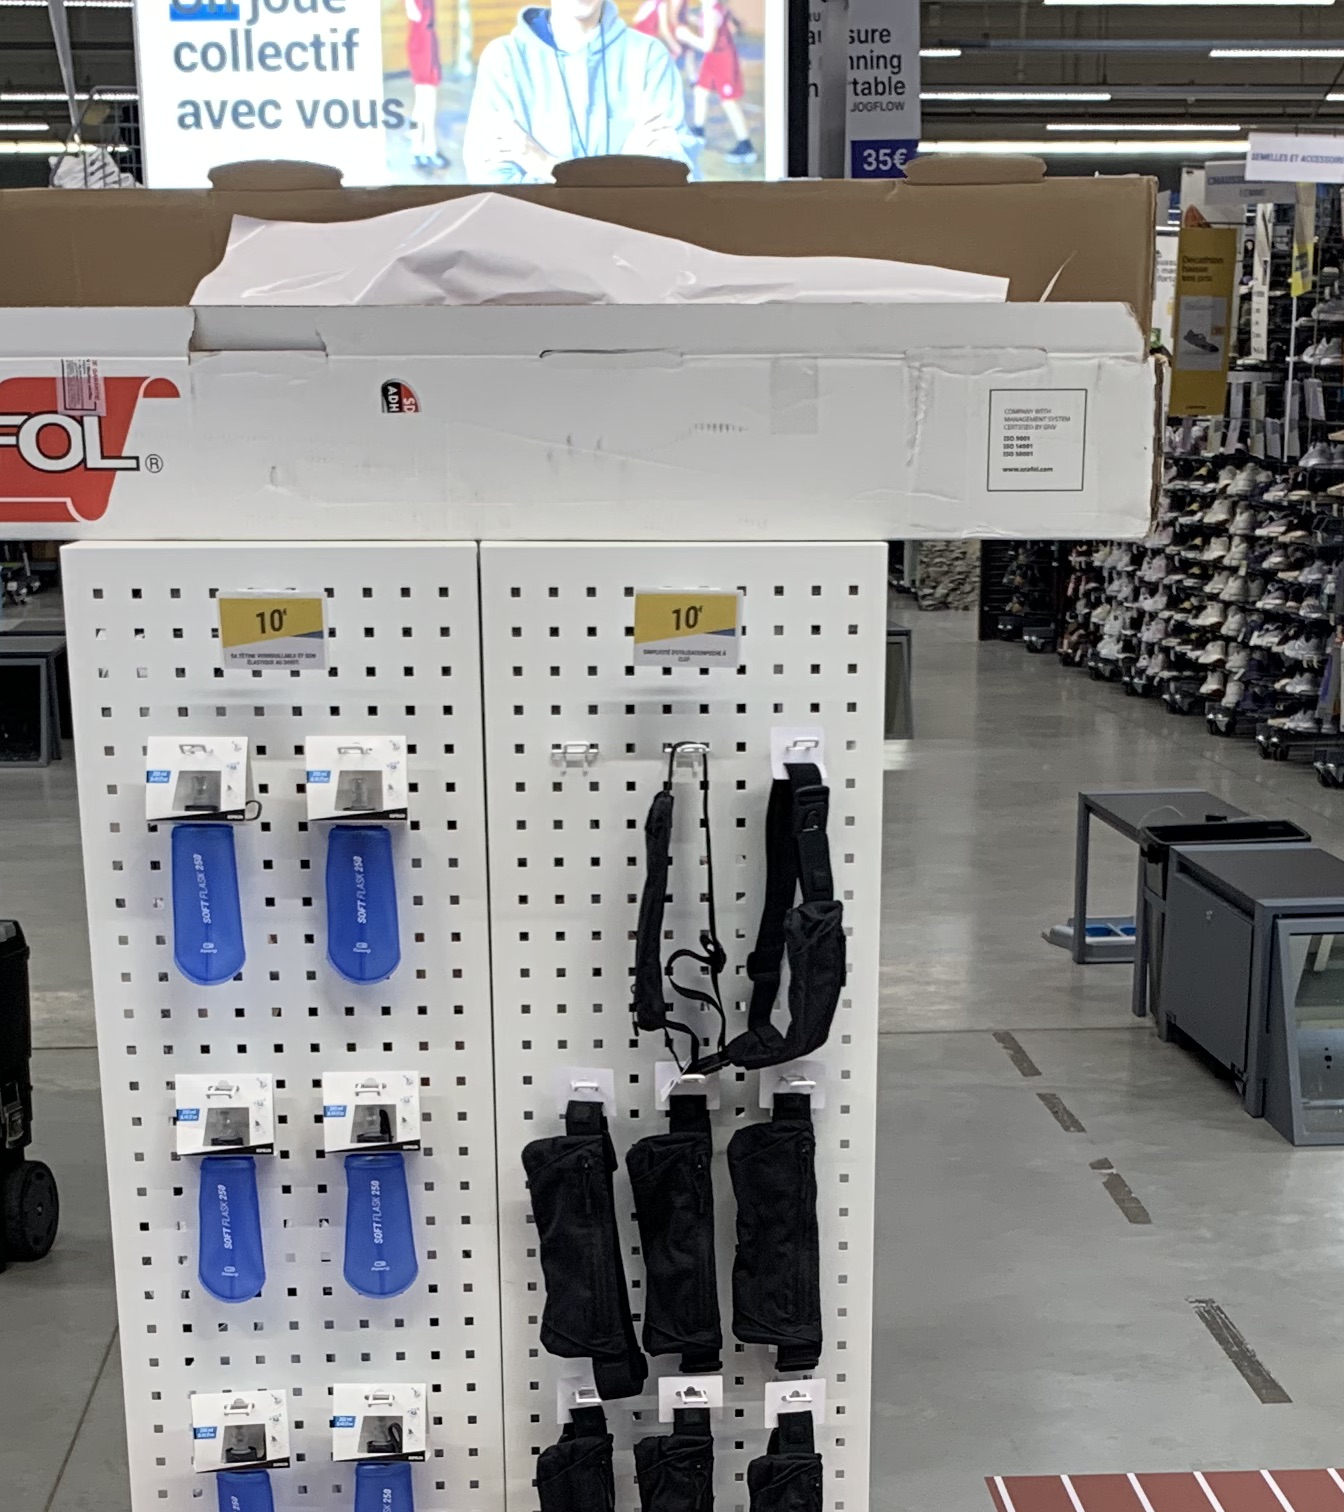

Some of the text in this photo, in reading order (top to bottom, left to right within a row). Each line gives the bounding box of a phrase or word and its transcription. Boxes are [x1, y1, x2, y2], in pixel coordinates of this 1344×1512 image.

[173, 28, 359, 73] collectif
[177, 98, 418, 130] avec vous.
[851, 101, 905, 112] JOGFLOW
[863, 148, 908, 171] 35€
[1251, 152, 1288, 163] SEMELLES
[1289, 154, 1299, 163] ET
[387, 385, 400, 412] ADH
[403, 397, 416, 413] SD
[193, 853, 212, 923] SOFT FLASK 250
[353, 856, 366, 923] SOFT FLASK 250
[217, 1184, 233, 1249] SOFT FLASK 250
[371, 1180, 383, 1244] SOFT FLASK 250
[231, 1496, 240, 1511] 250
[383, 1489, 392, 1503] 250
